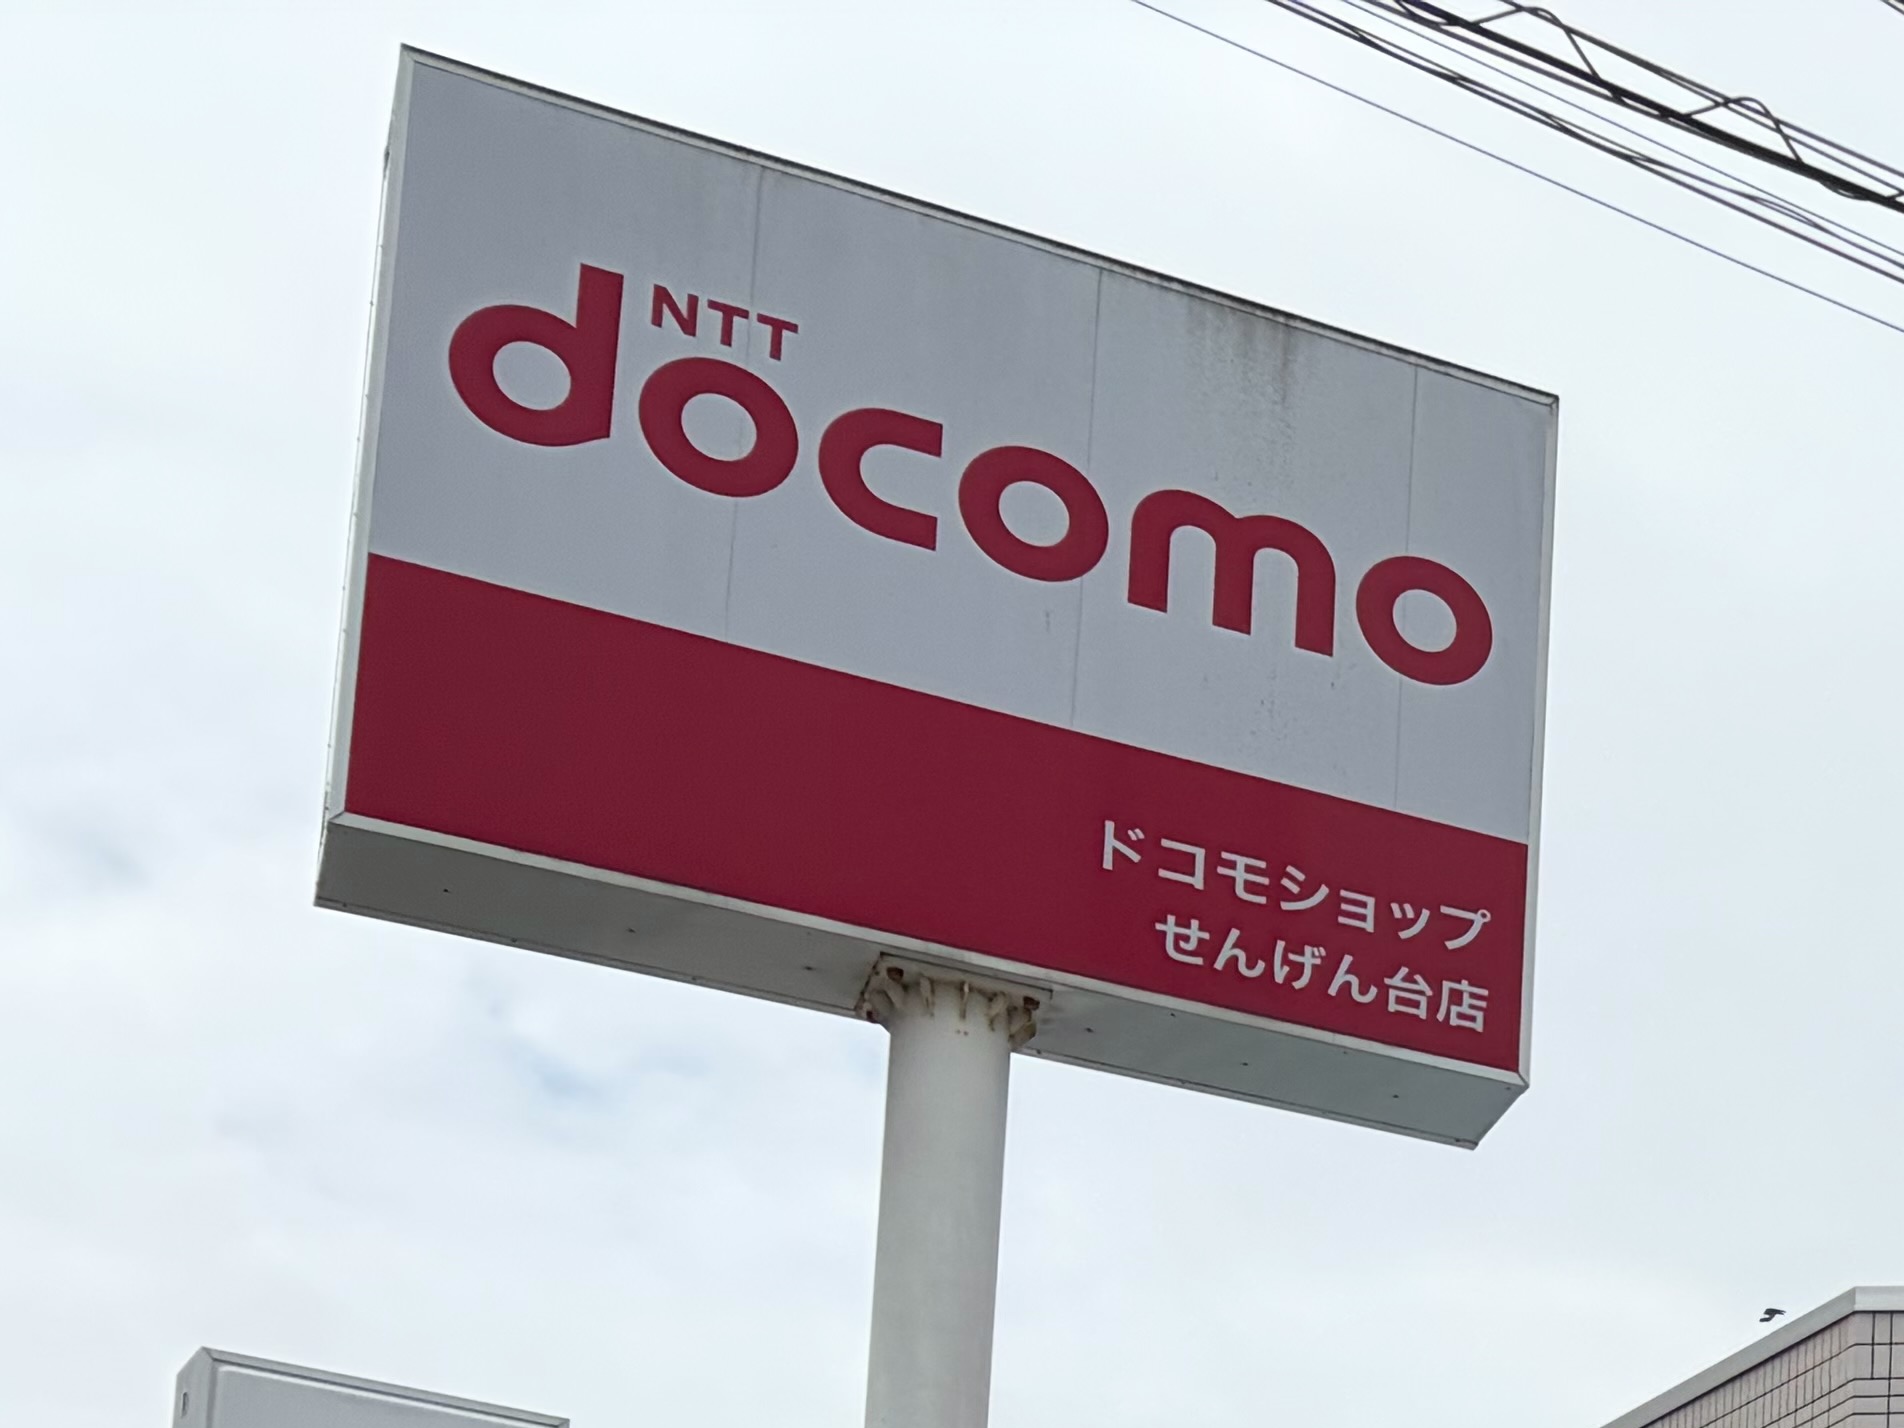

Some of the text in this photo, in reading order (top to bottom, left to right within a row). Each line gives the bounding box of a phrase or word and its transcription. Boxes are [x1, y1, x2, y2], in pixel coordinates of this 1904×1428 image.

[650, 283, 799, 362] NTT
[448, 264, 1493, 687] docomo
[1101, 820, 1491, 953] ドコモショップ
[1154, 913, 1489, 1033] せんげん台店
